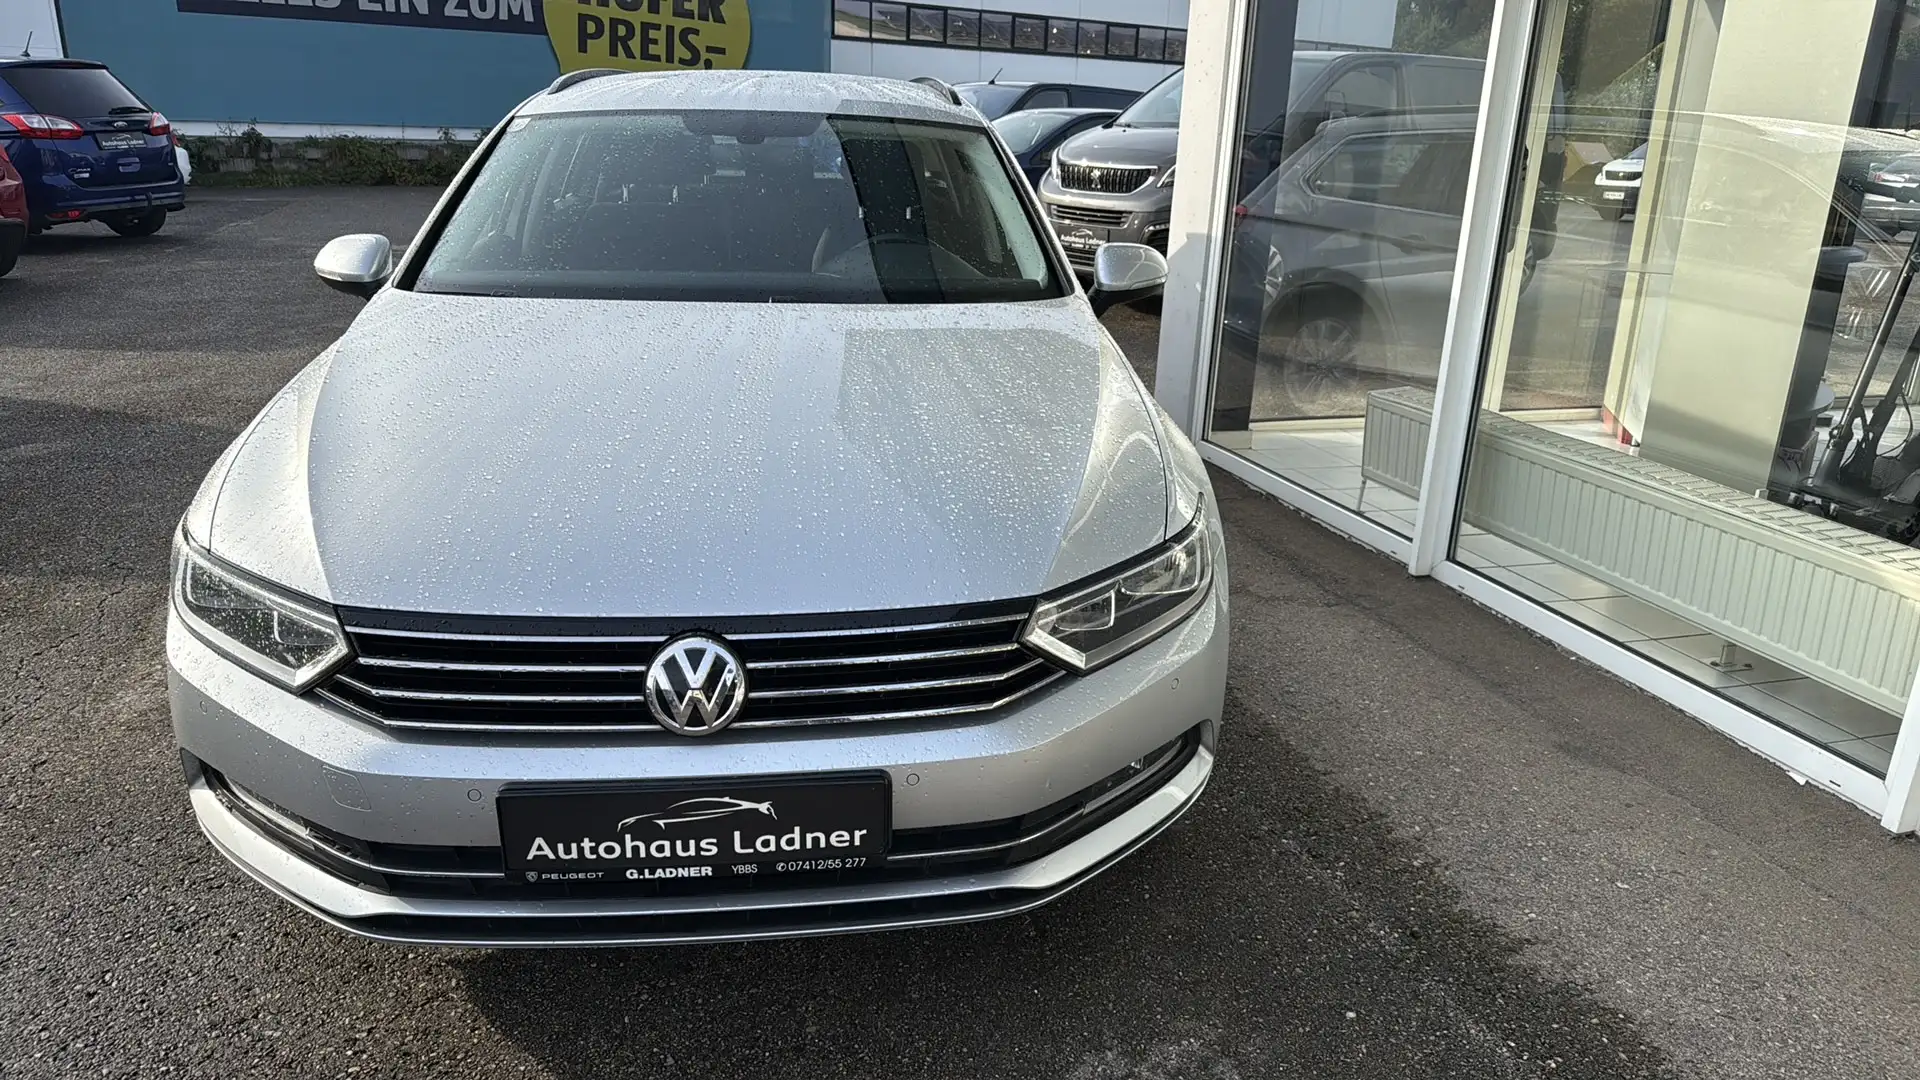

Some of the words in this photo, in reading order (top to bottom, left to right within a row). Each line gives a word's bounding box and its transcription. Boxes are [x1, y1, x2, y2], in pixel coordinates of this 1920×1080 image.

[526, 834, 718, 861] Autohaus
[734, 826, 867, 854] Ladner
[541, 871, 605, 880] PEUGEOT
[625, 866, 713, 880] G.LADNER
[731, 864, 758, 874] YBBS
[788, 859, 842, 871] 07412/55
[845, 857, 866, 868] 277
